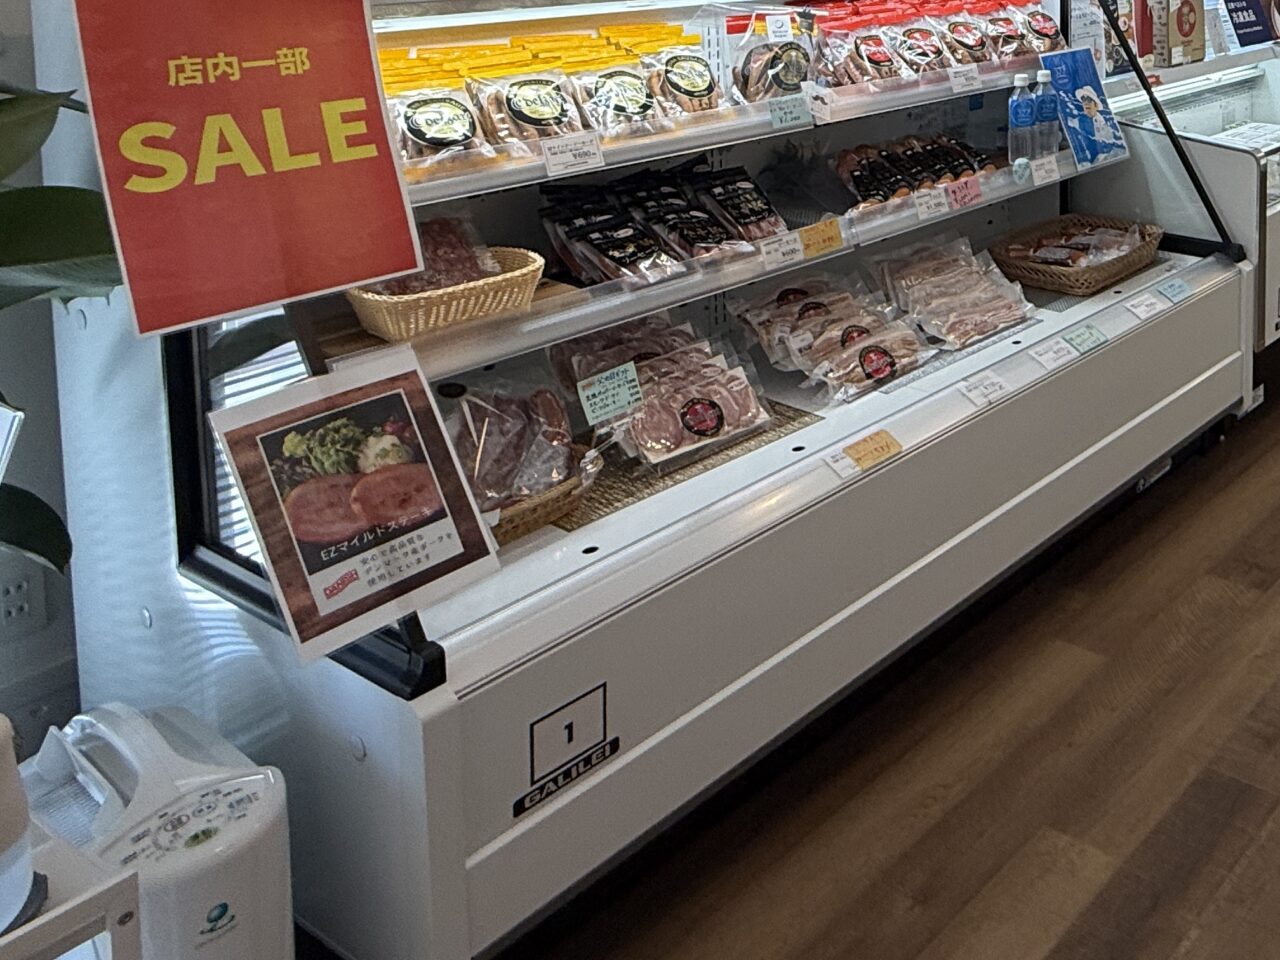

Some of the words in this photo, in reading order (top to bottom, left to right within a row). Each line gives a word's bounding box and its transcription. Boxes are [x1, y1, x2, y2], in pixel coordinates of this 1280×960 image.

[167, 46, 312, 87] 店内一部
[118, 97, 379, 194] SALE
[320, 506, 433, 561] EZマイルドステーキ
[564, 721, 574, 744] 1
[523, 743, 611, 809] GALILEI
